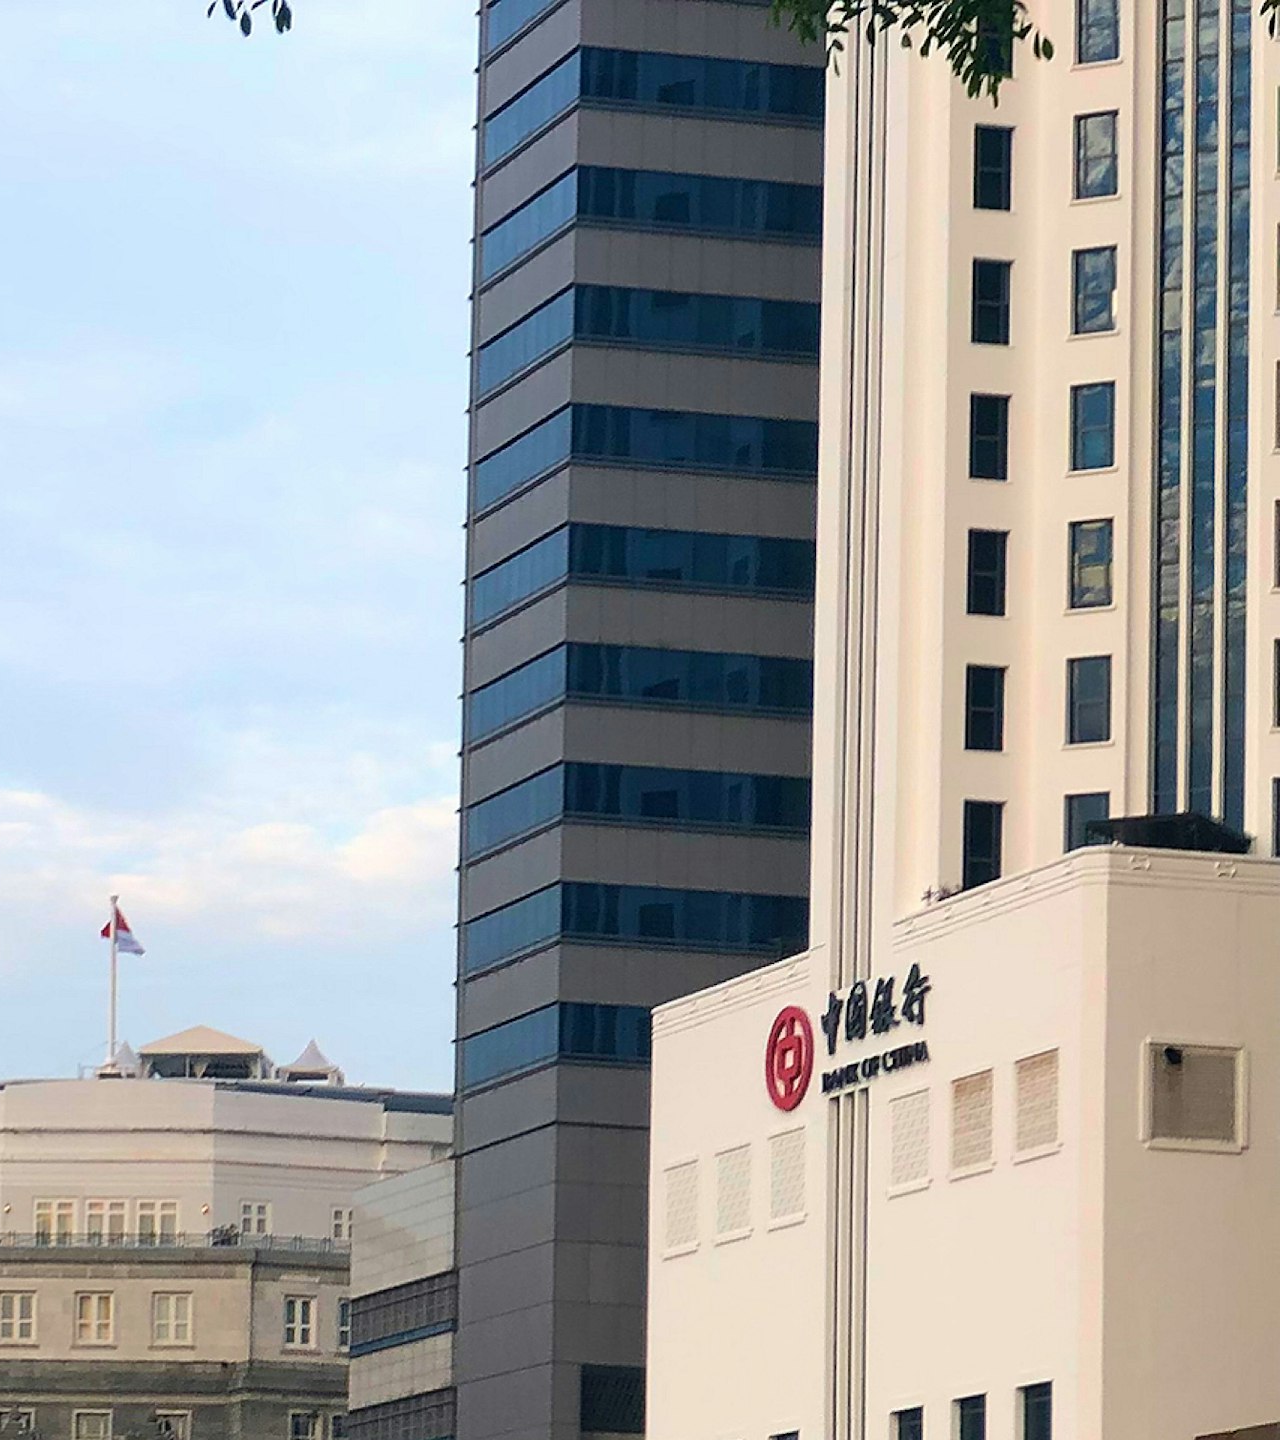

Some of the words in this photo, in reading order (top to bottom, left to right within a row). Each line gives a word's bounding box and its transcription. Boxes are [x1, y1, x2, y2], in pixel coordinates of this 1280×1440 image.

[821, 1064, 860, 1093] BANK
[861, 1056, 880, 1078] OF
[882, 1041, 930, 1072] CHINA
